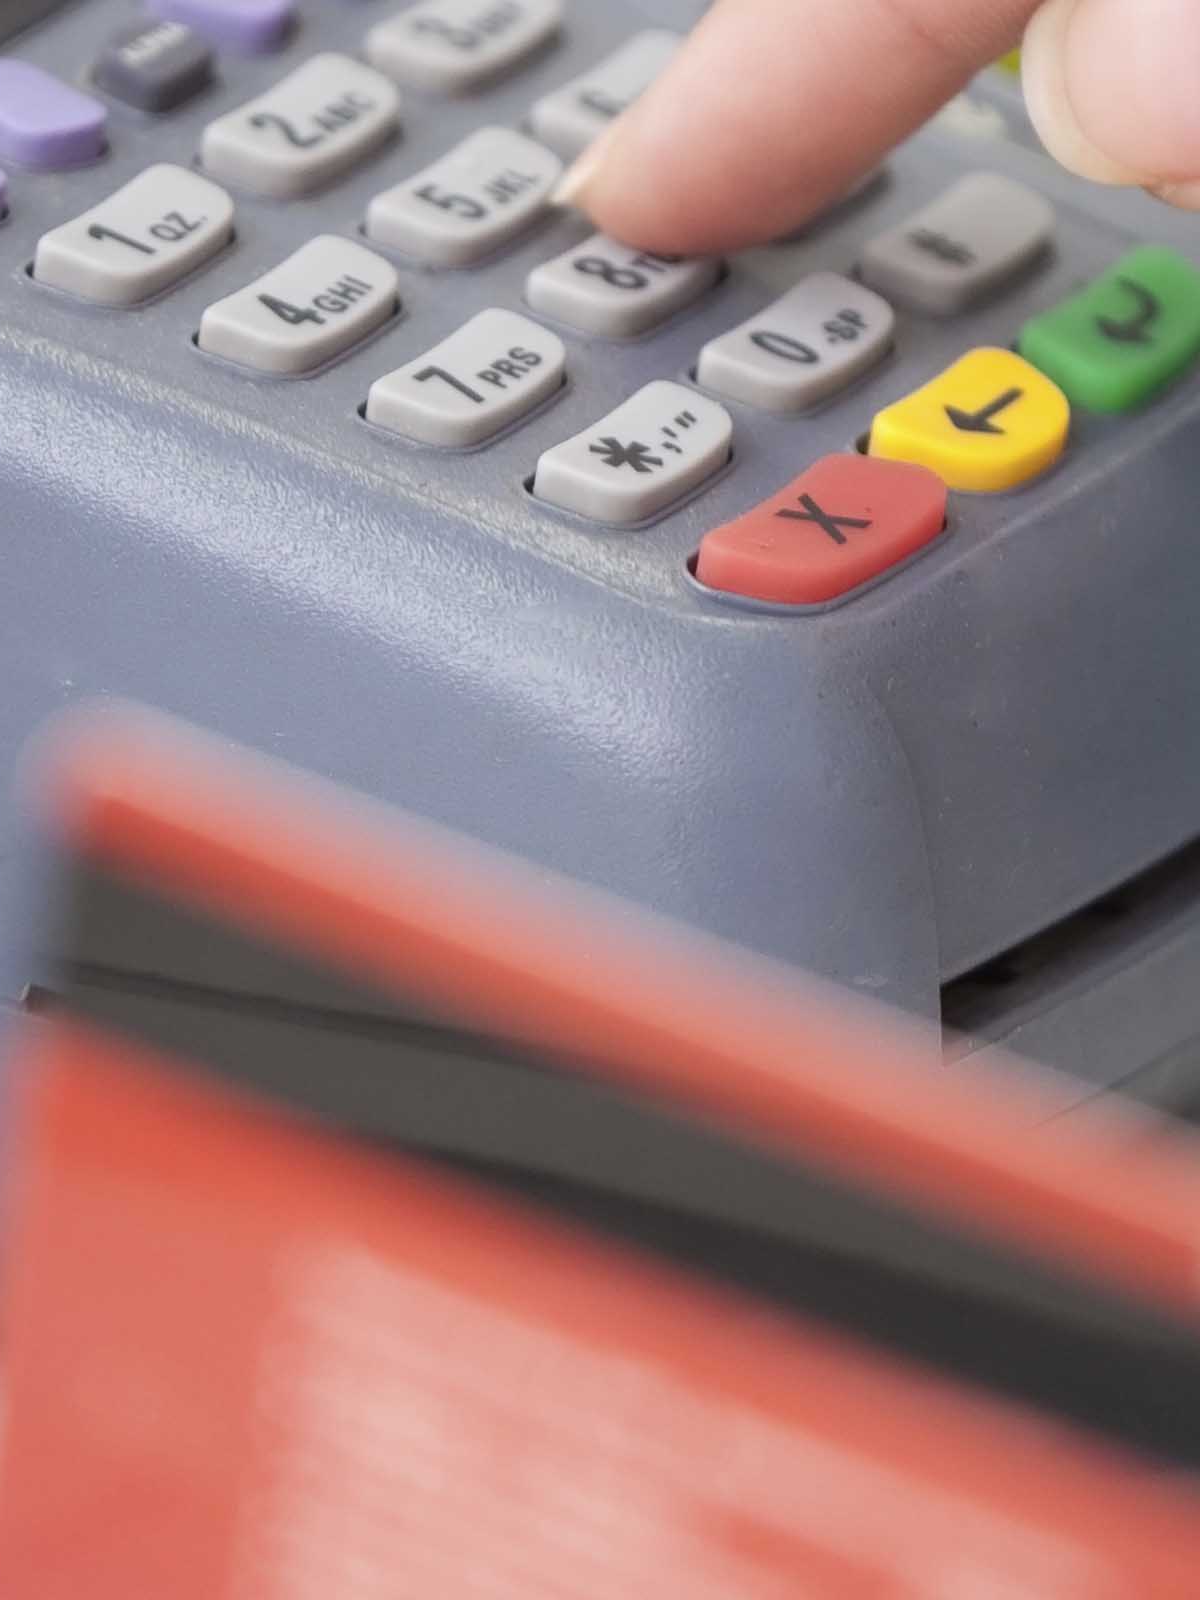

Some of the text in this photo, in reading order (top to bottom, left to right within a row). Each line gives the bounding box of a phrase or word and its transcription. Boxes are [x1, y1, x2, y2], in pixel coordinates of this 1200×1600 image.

[251, 112, 324, 148] 2
[412, 184, 487, 220] 5
[87, 223, 156, 255] 1
[573, 256, 646, 290] 8
[257, 274, 373, 325] 4 GHI
[749, 330, 820, 363] 0
[412, 346, 543, 404] 7 PRS
